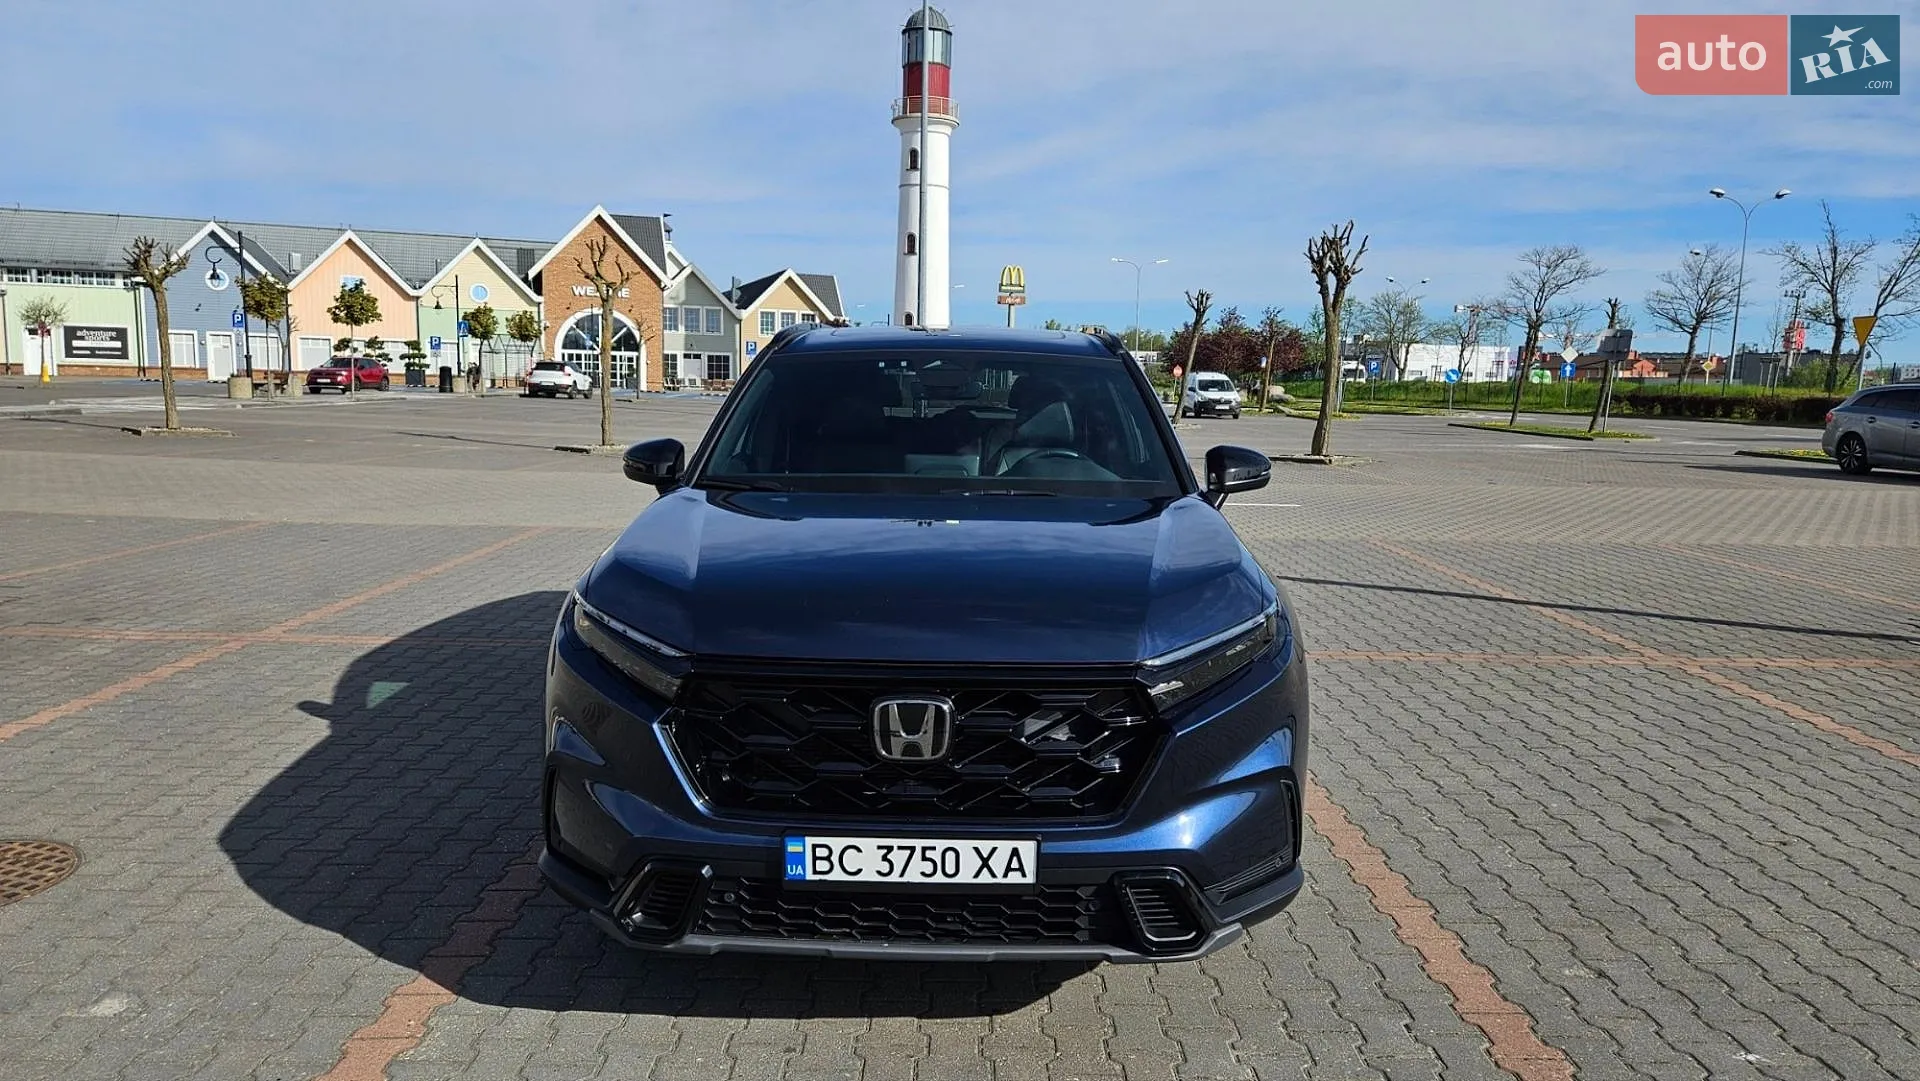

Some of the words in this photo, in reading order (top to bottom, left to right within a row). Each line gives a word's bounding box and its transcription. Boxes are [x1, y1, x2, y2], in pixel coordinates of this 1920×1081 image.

[76, 329, 117, 337] adventure
[811, 843, 865, 877] BC
[875, 845, 961, 879] 3750
[972, 846, 1027, 879] XA
[787, 864, 804, 876] UA
